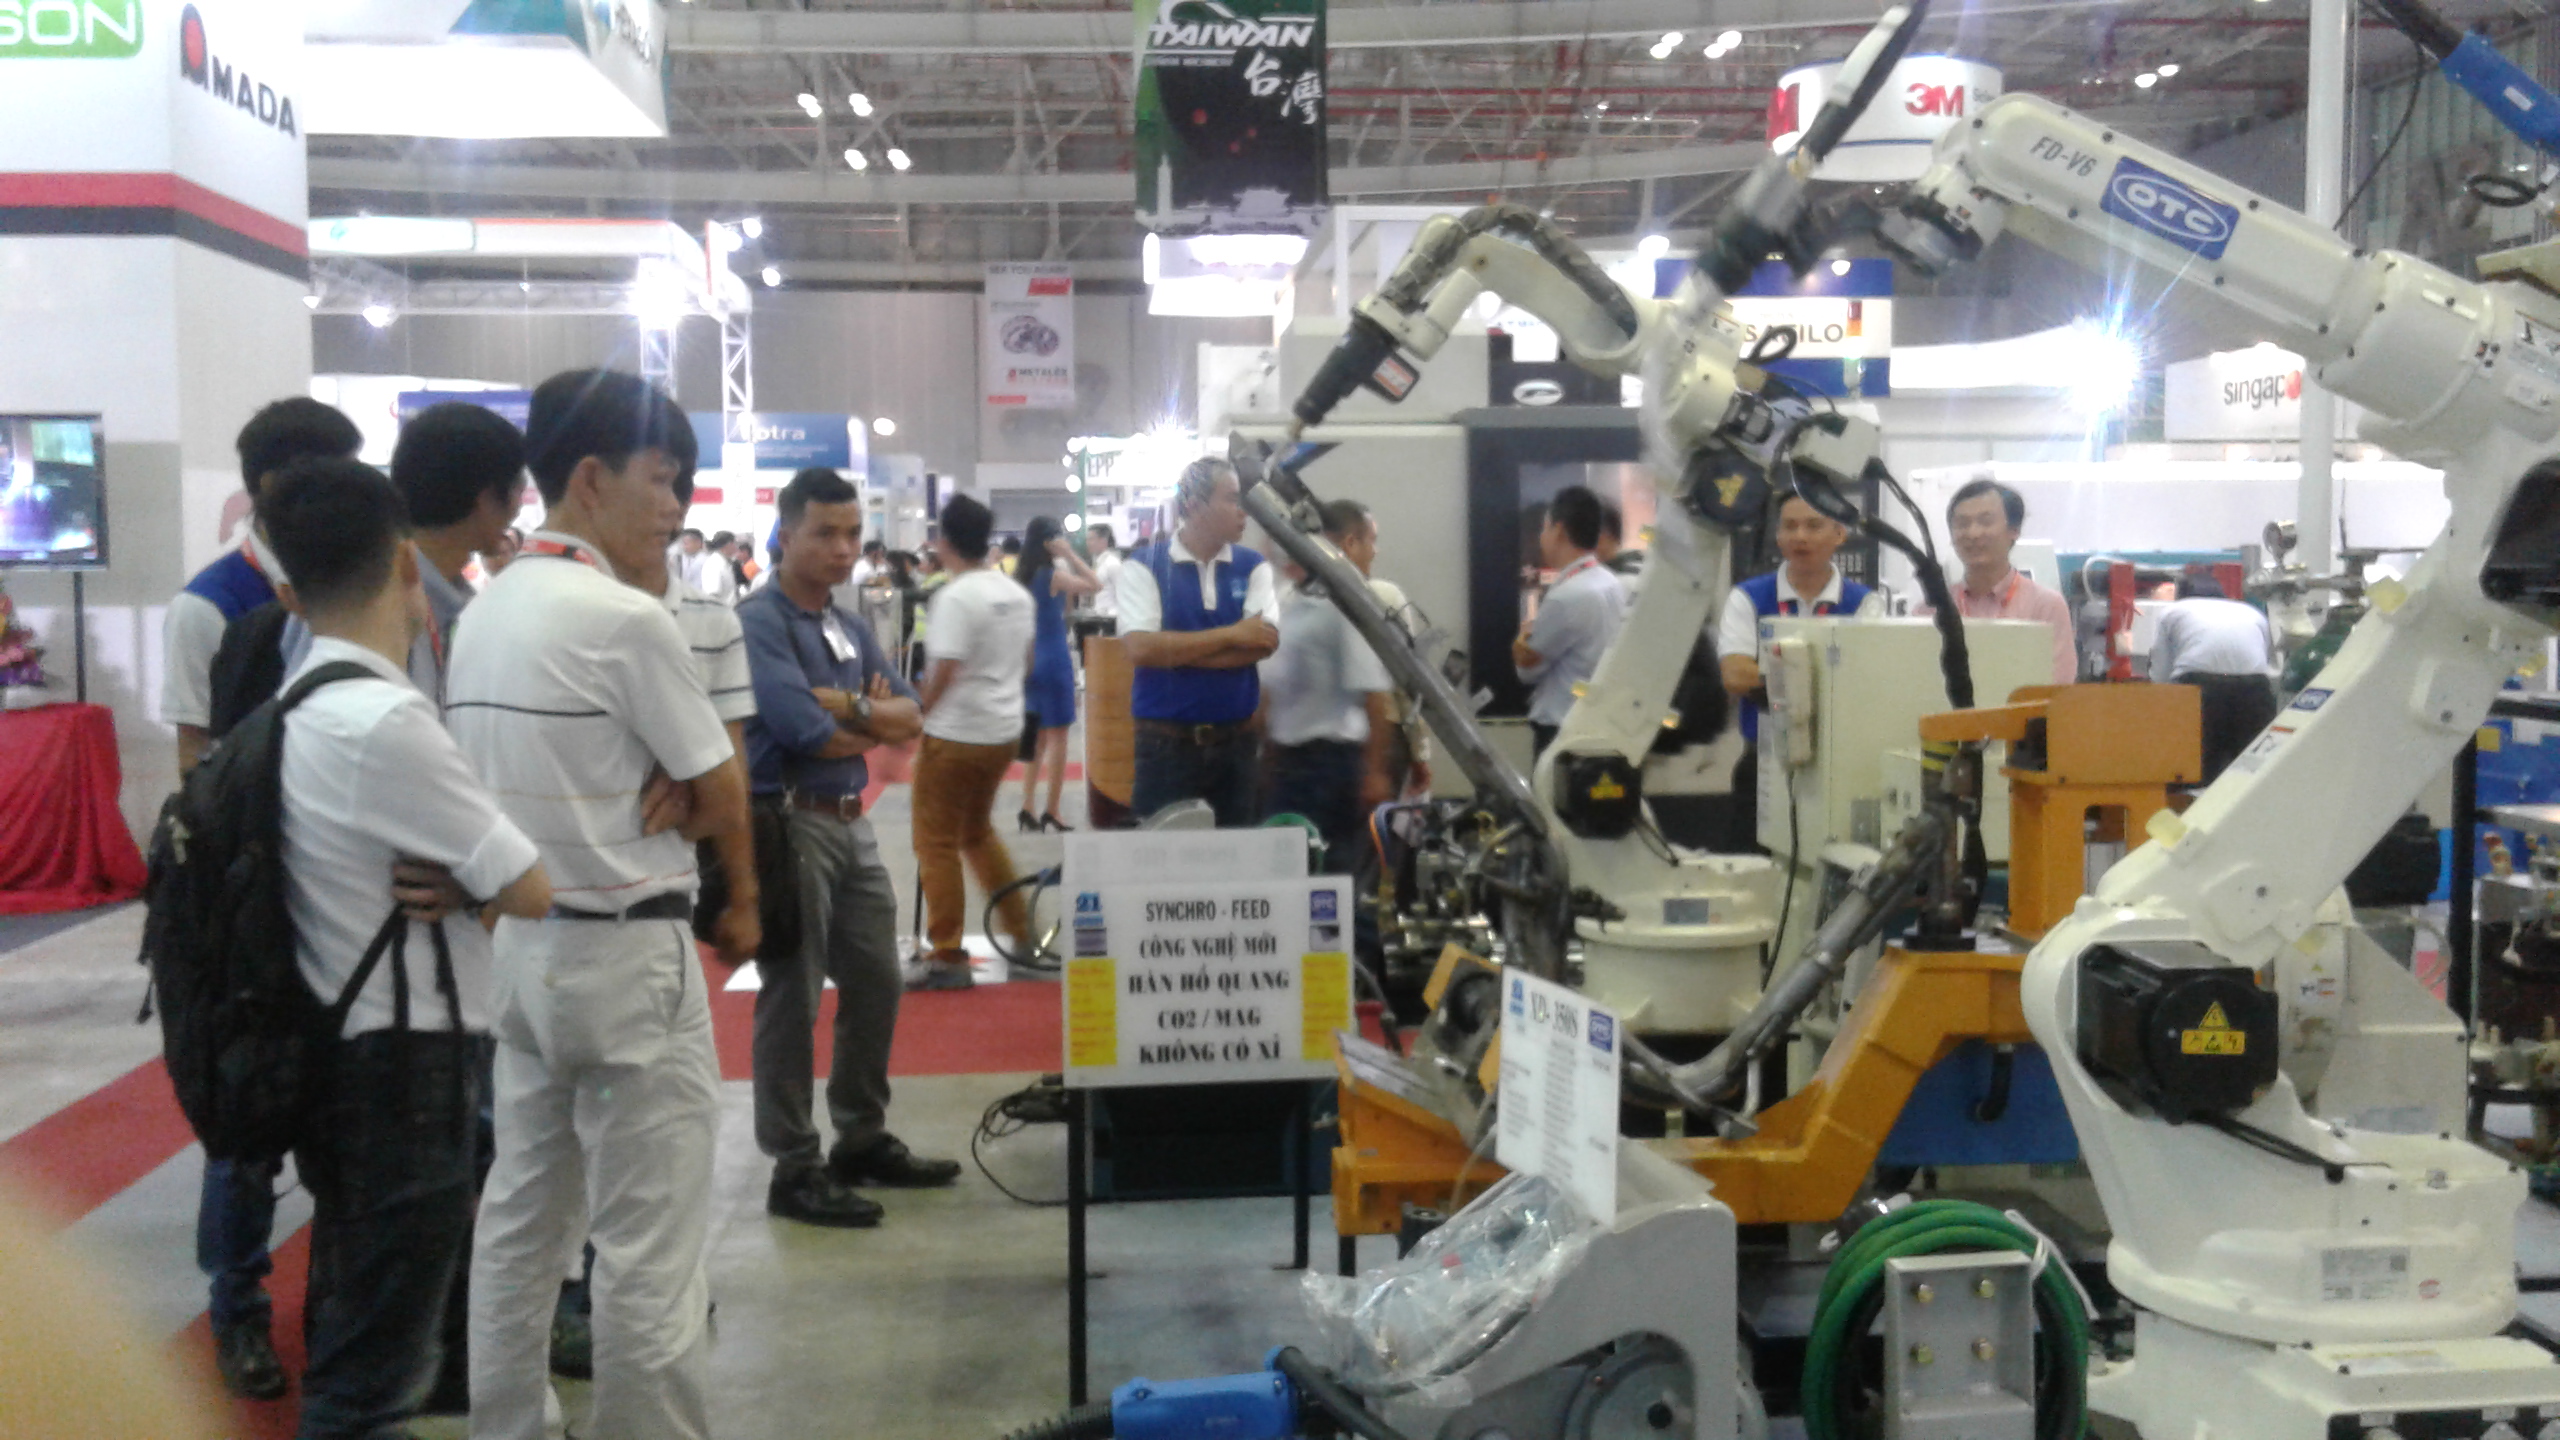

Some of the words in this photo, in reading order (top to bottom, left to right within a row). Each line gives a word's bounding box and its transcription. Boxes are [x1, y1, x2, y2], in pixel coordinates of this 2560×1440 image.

[1148, 17, 1314, 48] TAIWAN
[1905, 82, 1964, 117] 3M
[2030, 136, 2097, 177] FD-V6
[2126, 182, 2214, 235] OTC
[1146, 900, 1217, 922] SYNCHRO
[1232, 898, 1271, 920] FEED
[1158, 1009, 1196, 1029] CO2
[1216, 1007, 1261, 1027] MAG
